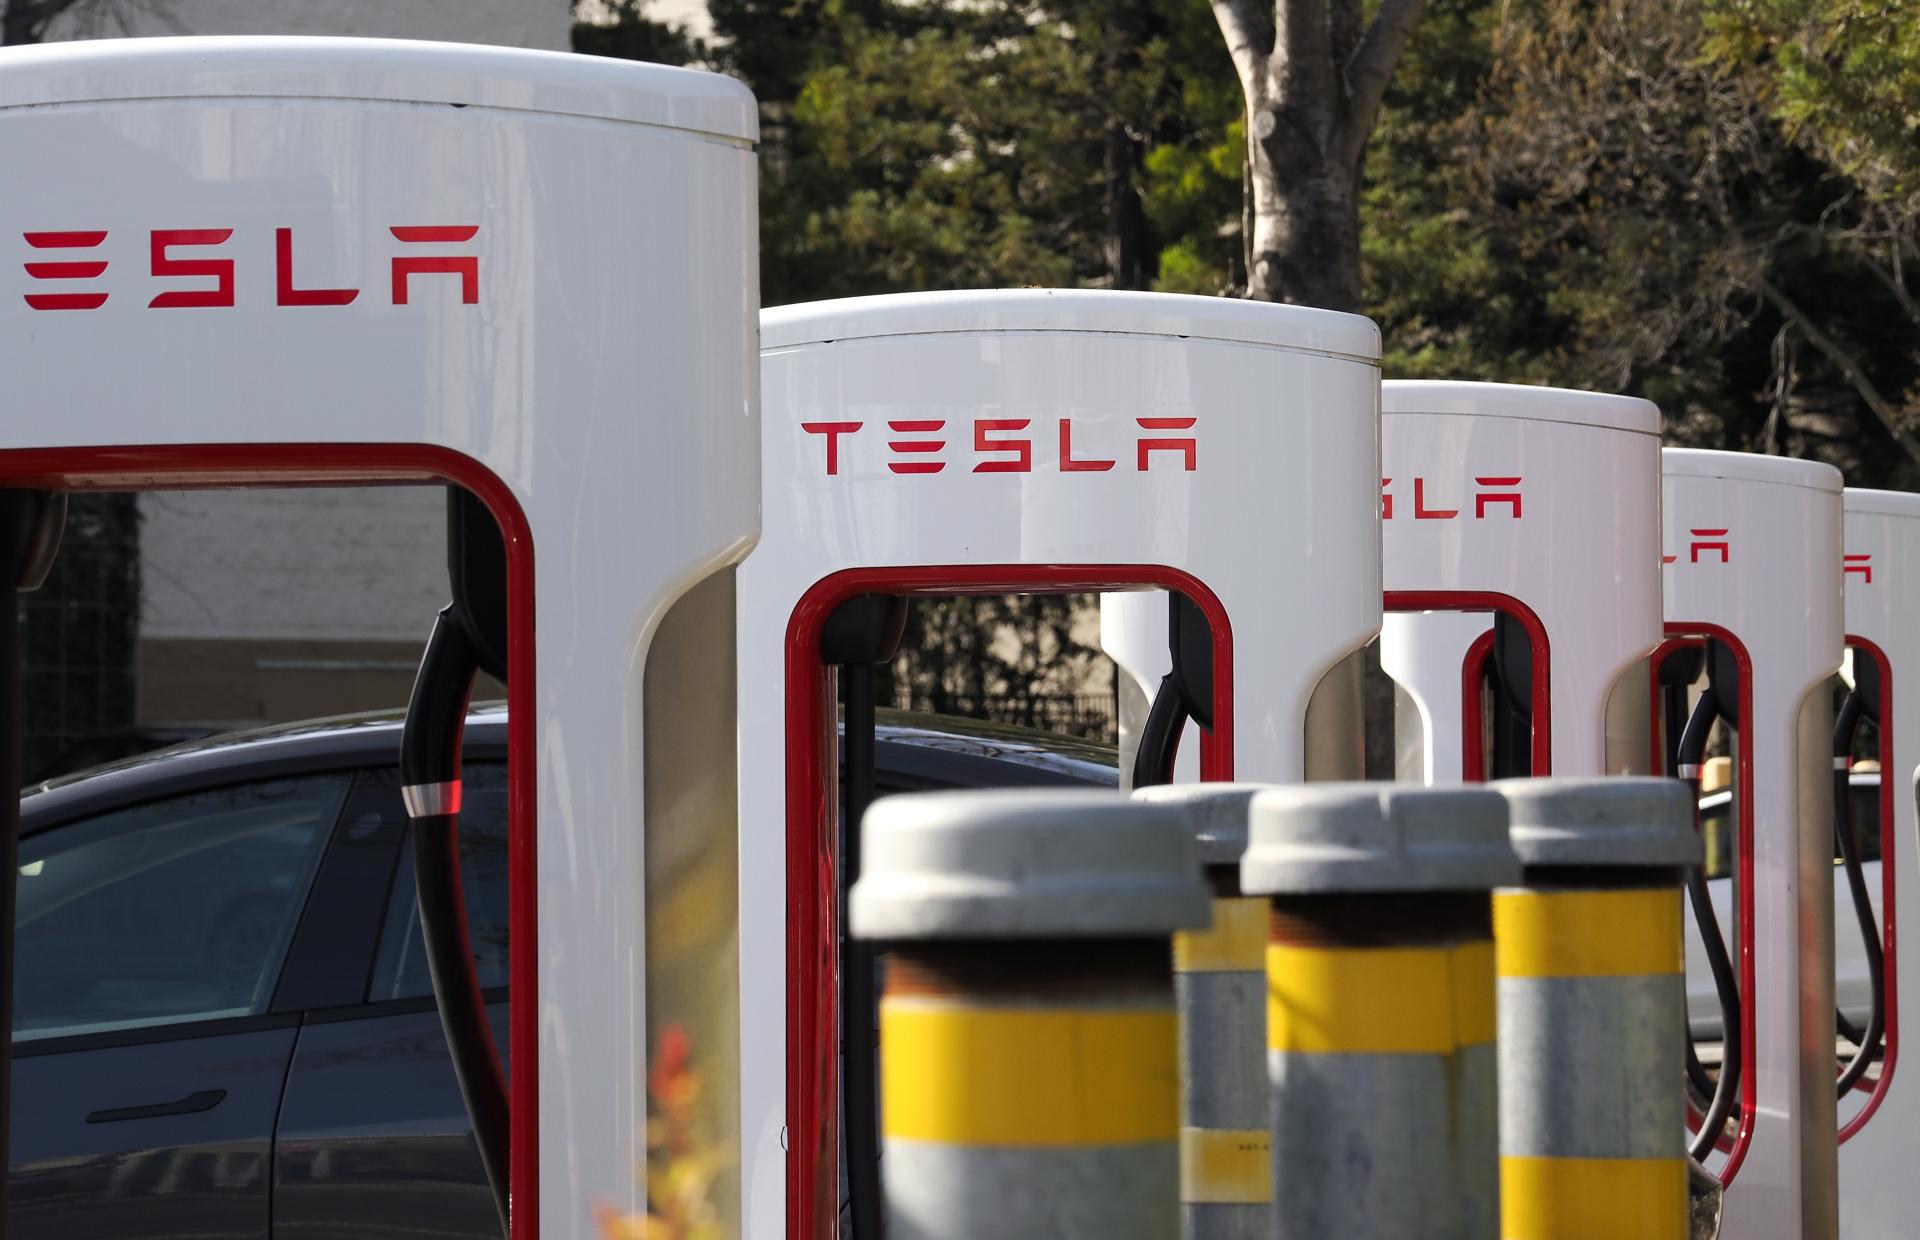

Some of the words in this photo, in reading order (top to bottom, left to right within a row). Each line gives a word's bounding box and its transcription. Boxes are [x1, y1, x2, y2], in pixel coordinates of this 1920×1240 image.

[23, 226, 480, 311] ESLA
[801, 418, 1197, 476] TESLA
[1382, 477, 1522, 519] LA
[1663, 528, 1729, 563] A
